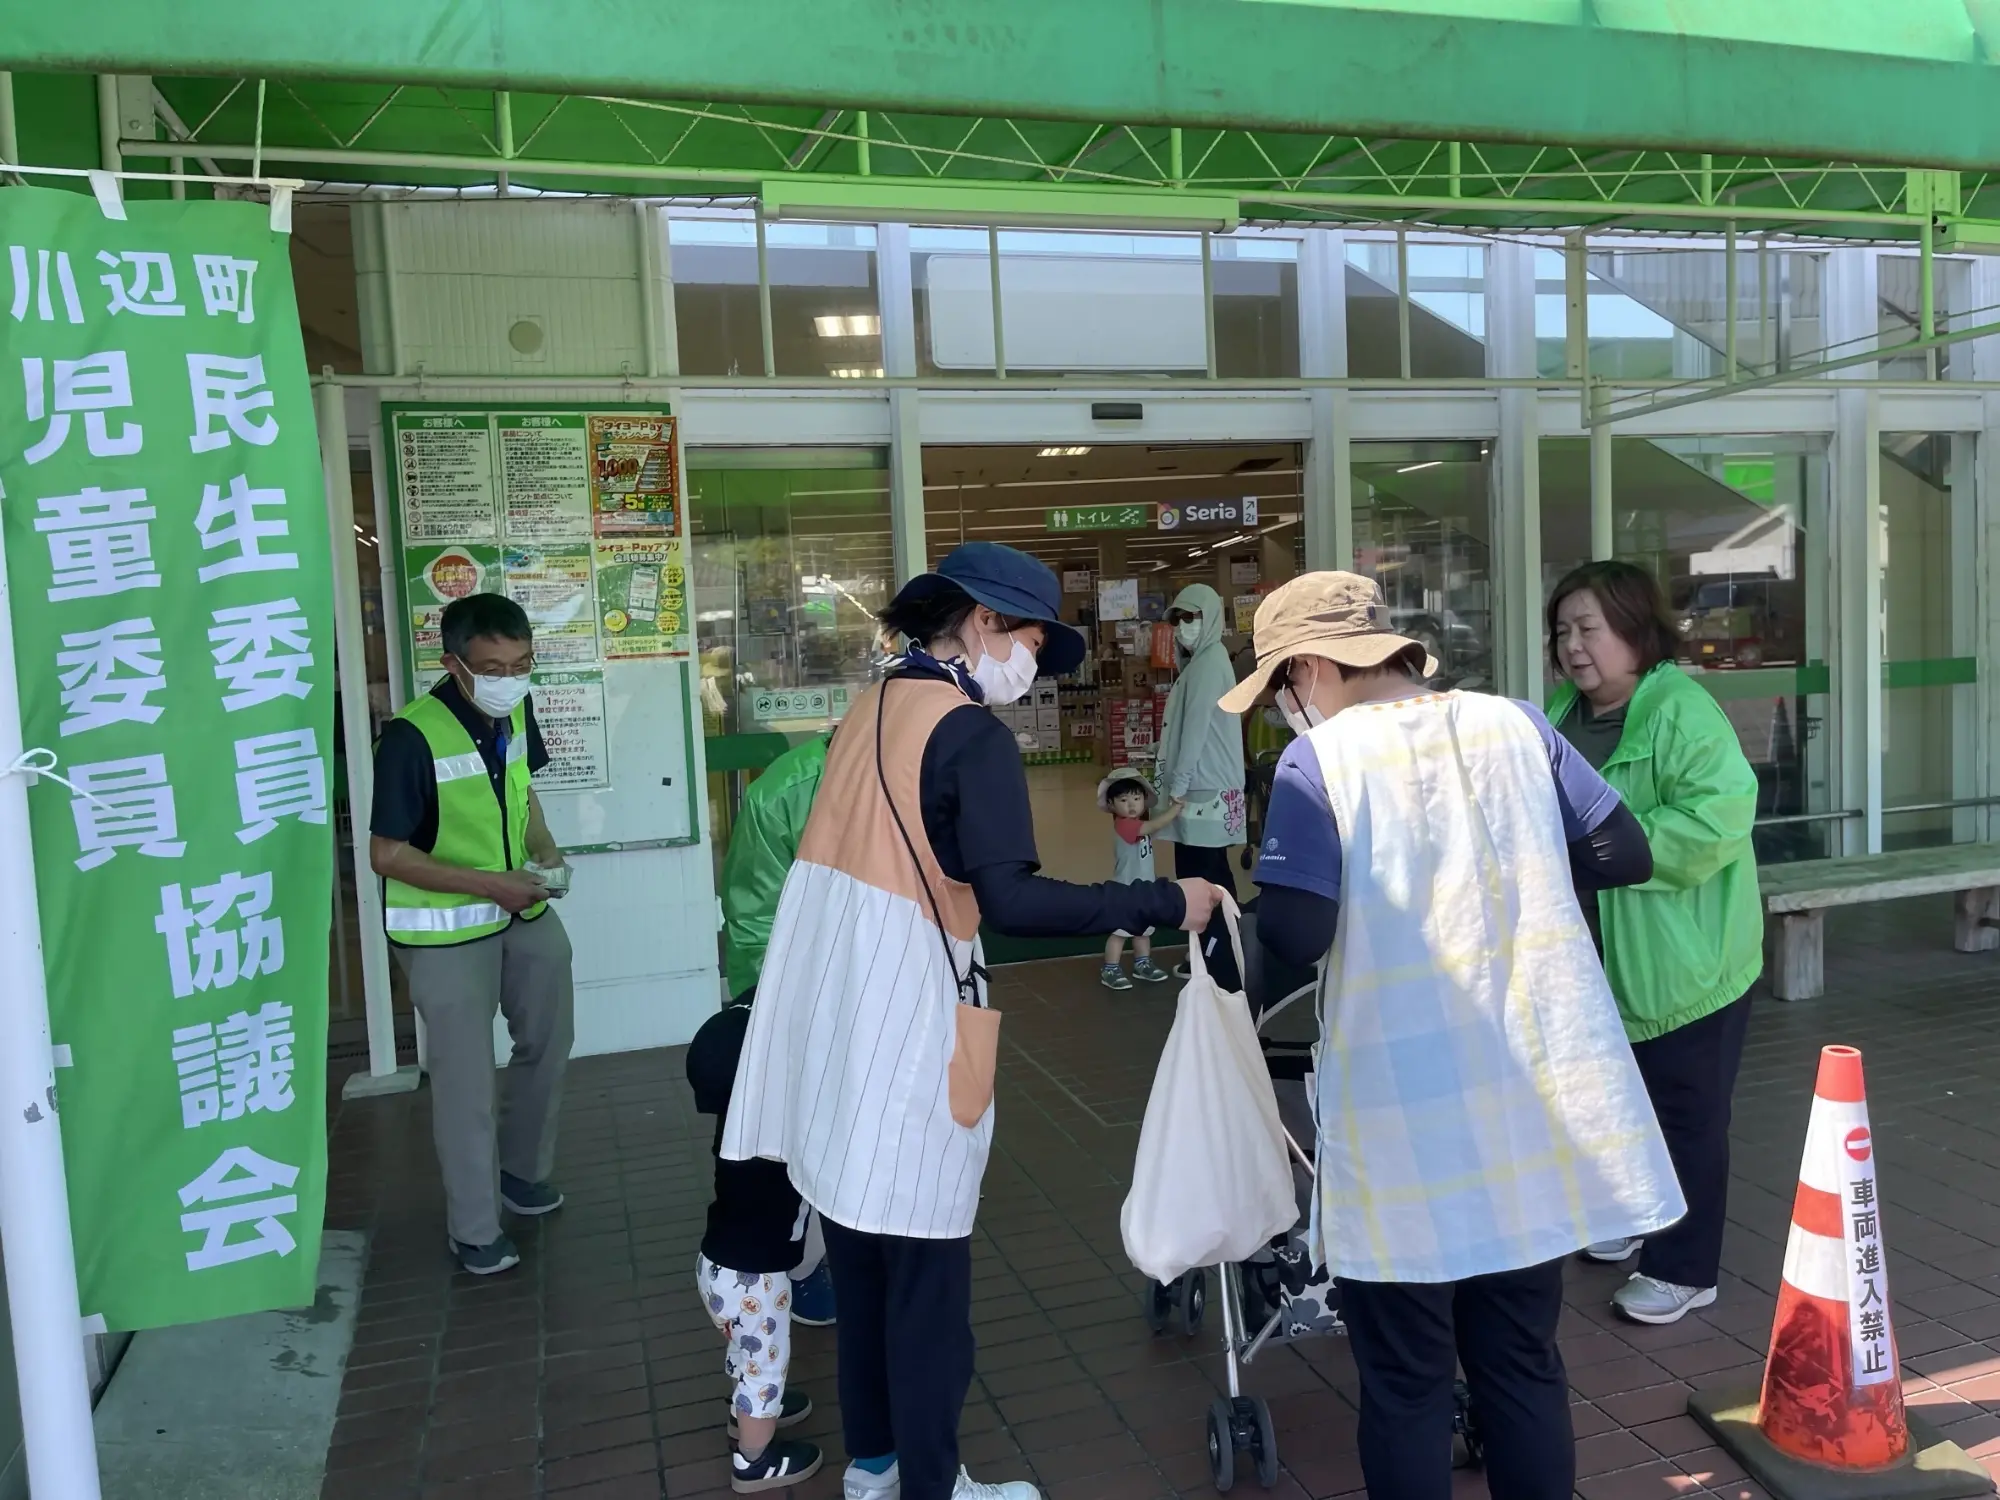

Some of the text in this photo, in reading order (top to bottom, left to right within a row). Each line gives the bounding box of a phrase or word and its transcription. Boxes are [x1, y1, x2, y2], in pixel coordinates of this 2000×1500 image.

[9, 246, 259, 324] 川辺町
[422, 417, 466, 428] お客様へ
[521, 416, 562, 427] お客様へ
[1076, 511, 1111, 524] トイレ
[1185, 502, 1237, 522] Seria
[1245, 513, 1256, 523] 2F
[186, 353, 327, 846] 民生委員
[22, 350, 187, 872] 児童委員
[540, 673, 579, 684] お客様へ
[155, 871, 301, 1272] 協議会
[1849, 1177, 1889, 1375] 車両進入禁止
